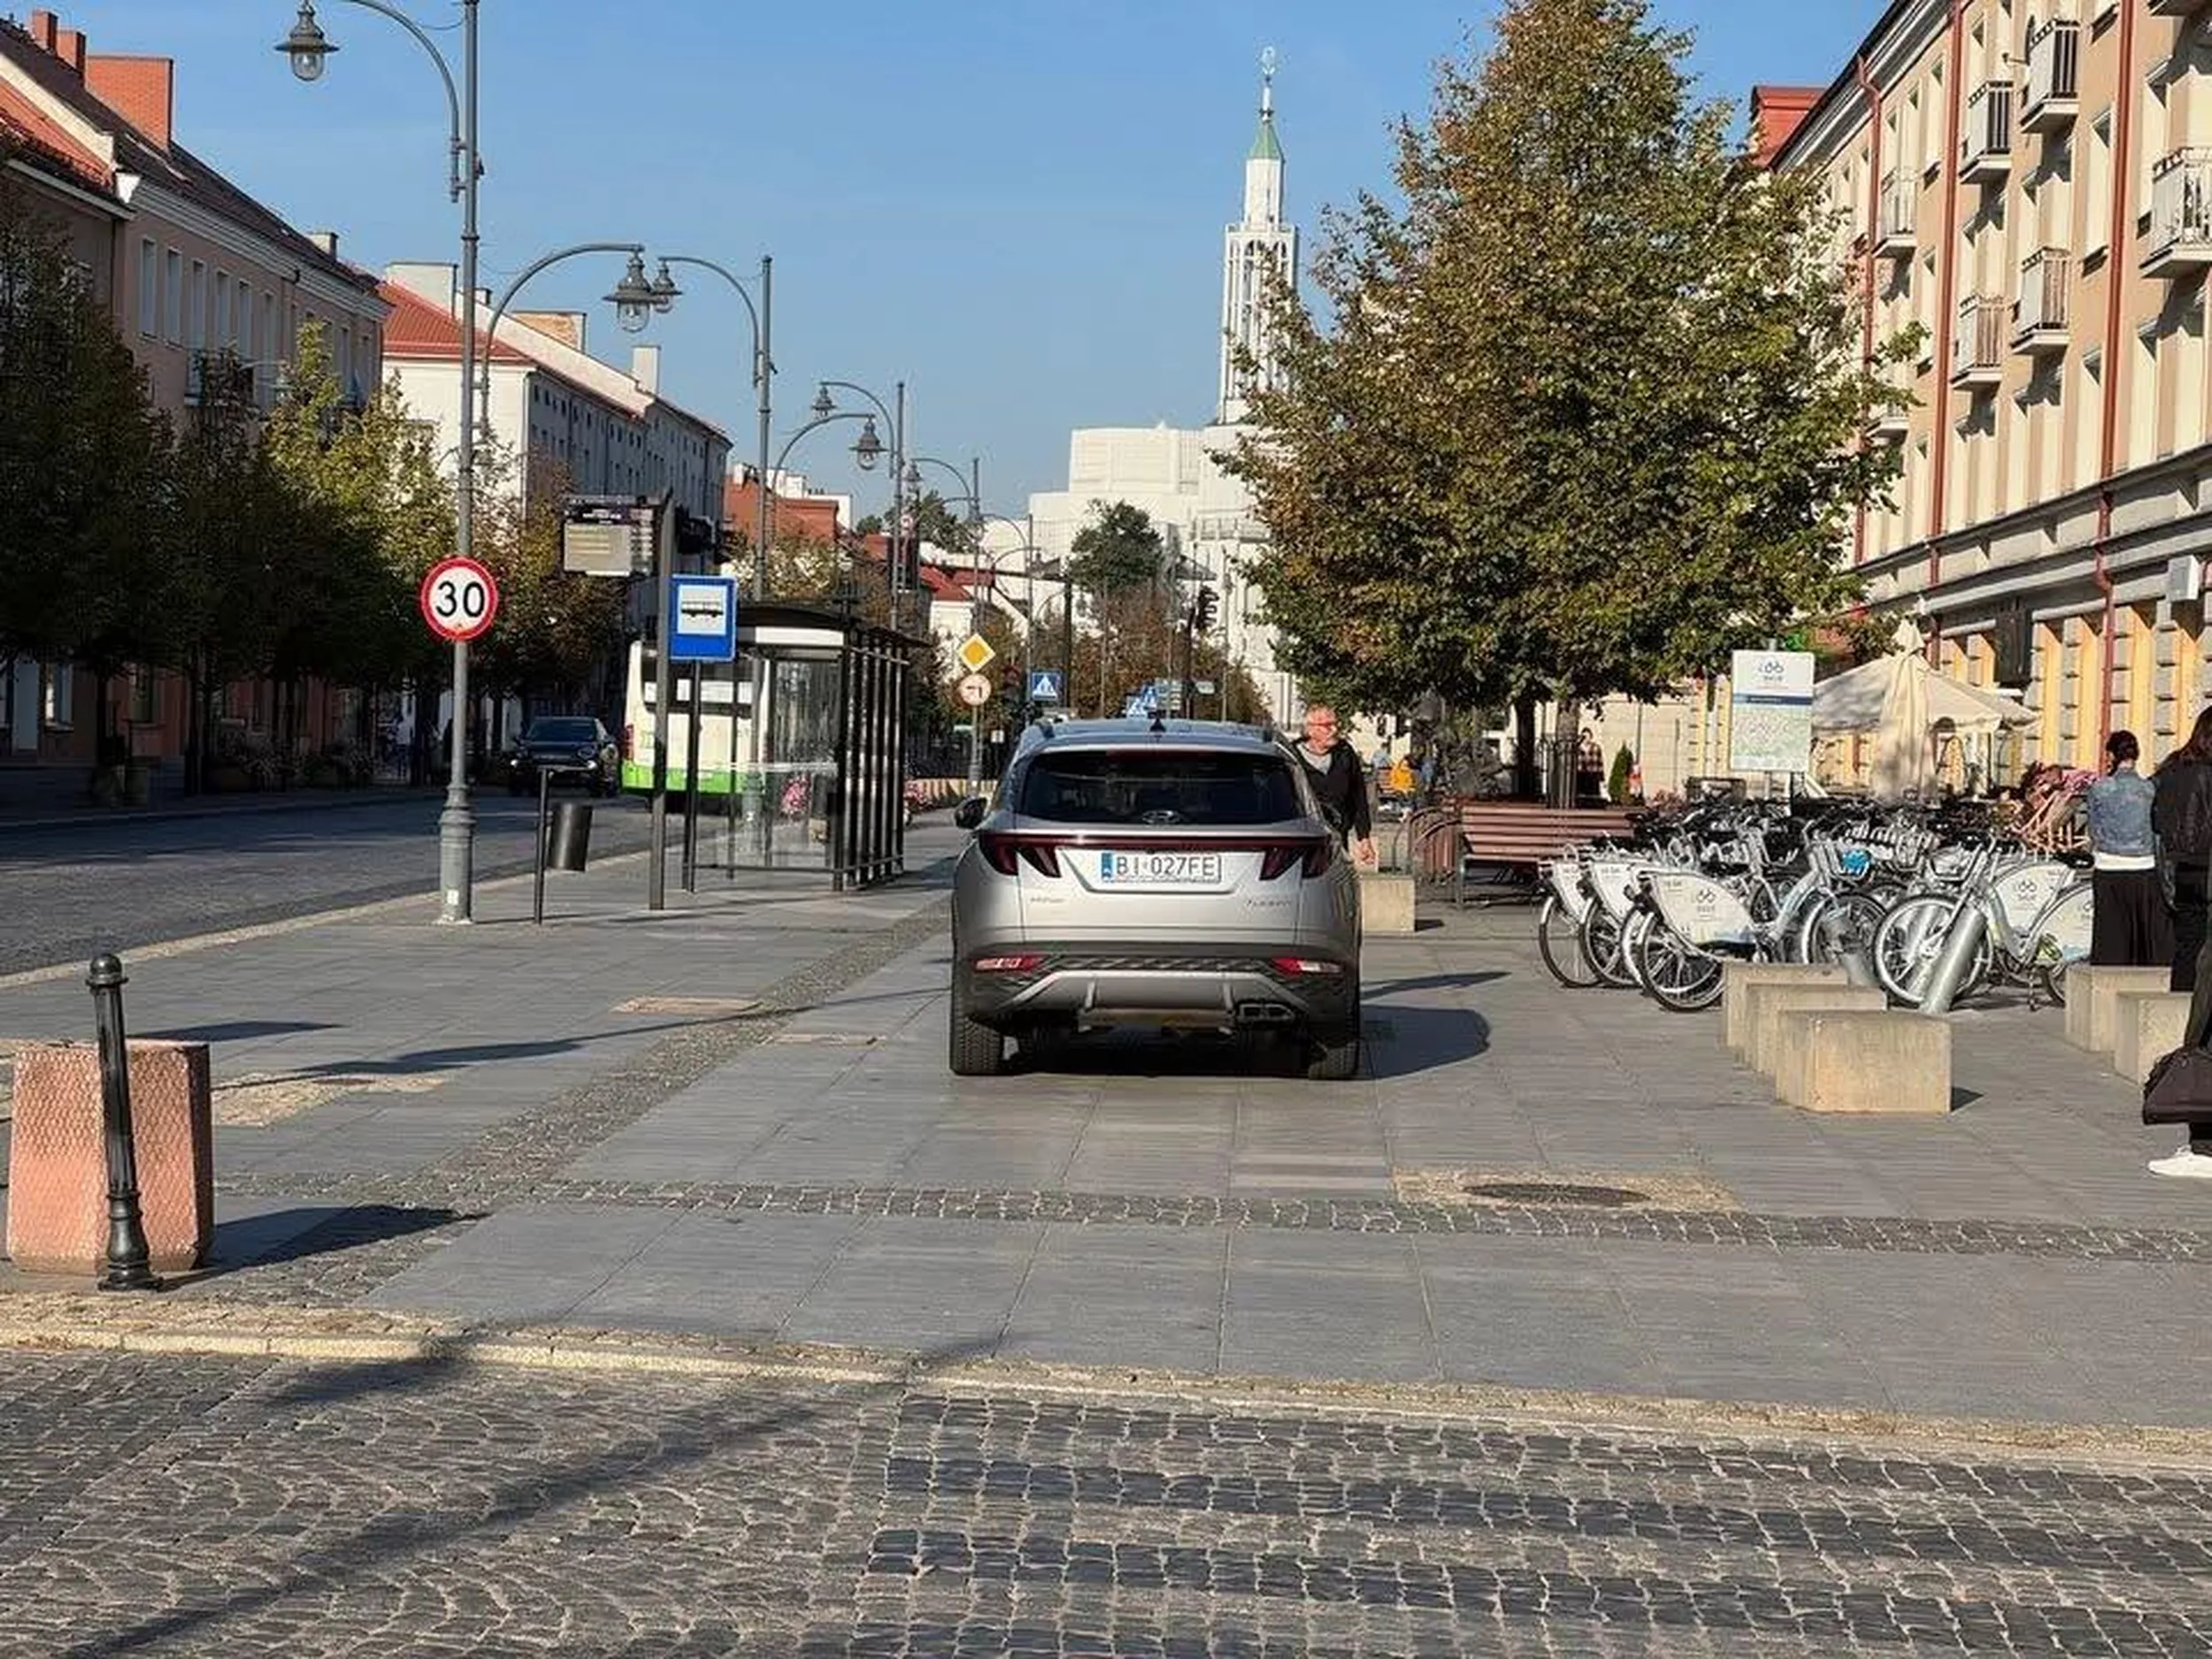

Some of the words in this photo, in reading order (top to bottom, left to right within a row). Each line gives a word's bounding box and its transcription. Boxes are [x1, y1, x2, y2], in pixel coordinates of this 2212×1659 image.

[436, 581, 485, 617] 30
[1116, 856, 1140, 876] BI
[1150, 856, 1215, 876] 027FE
